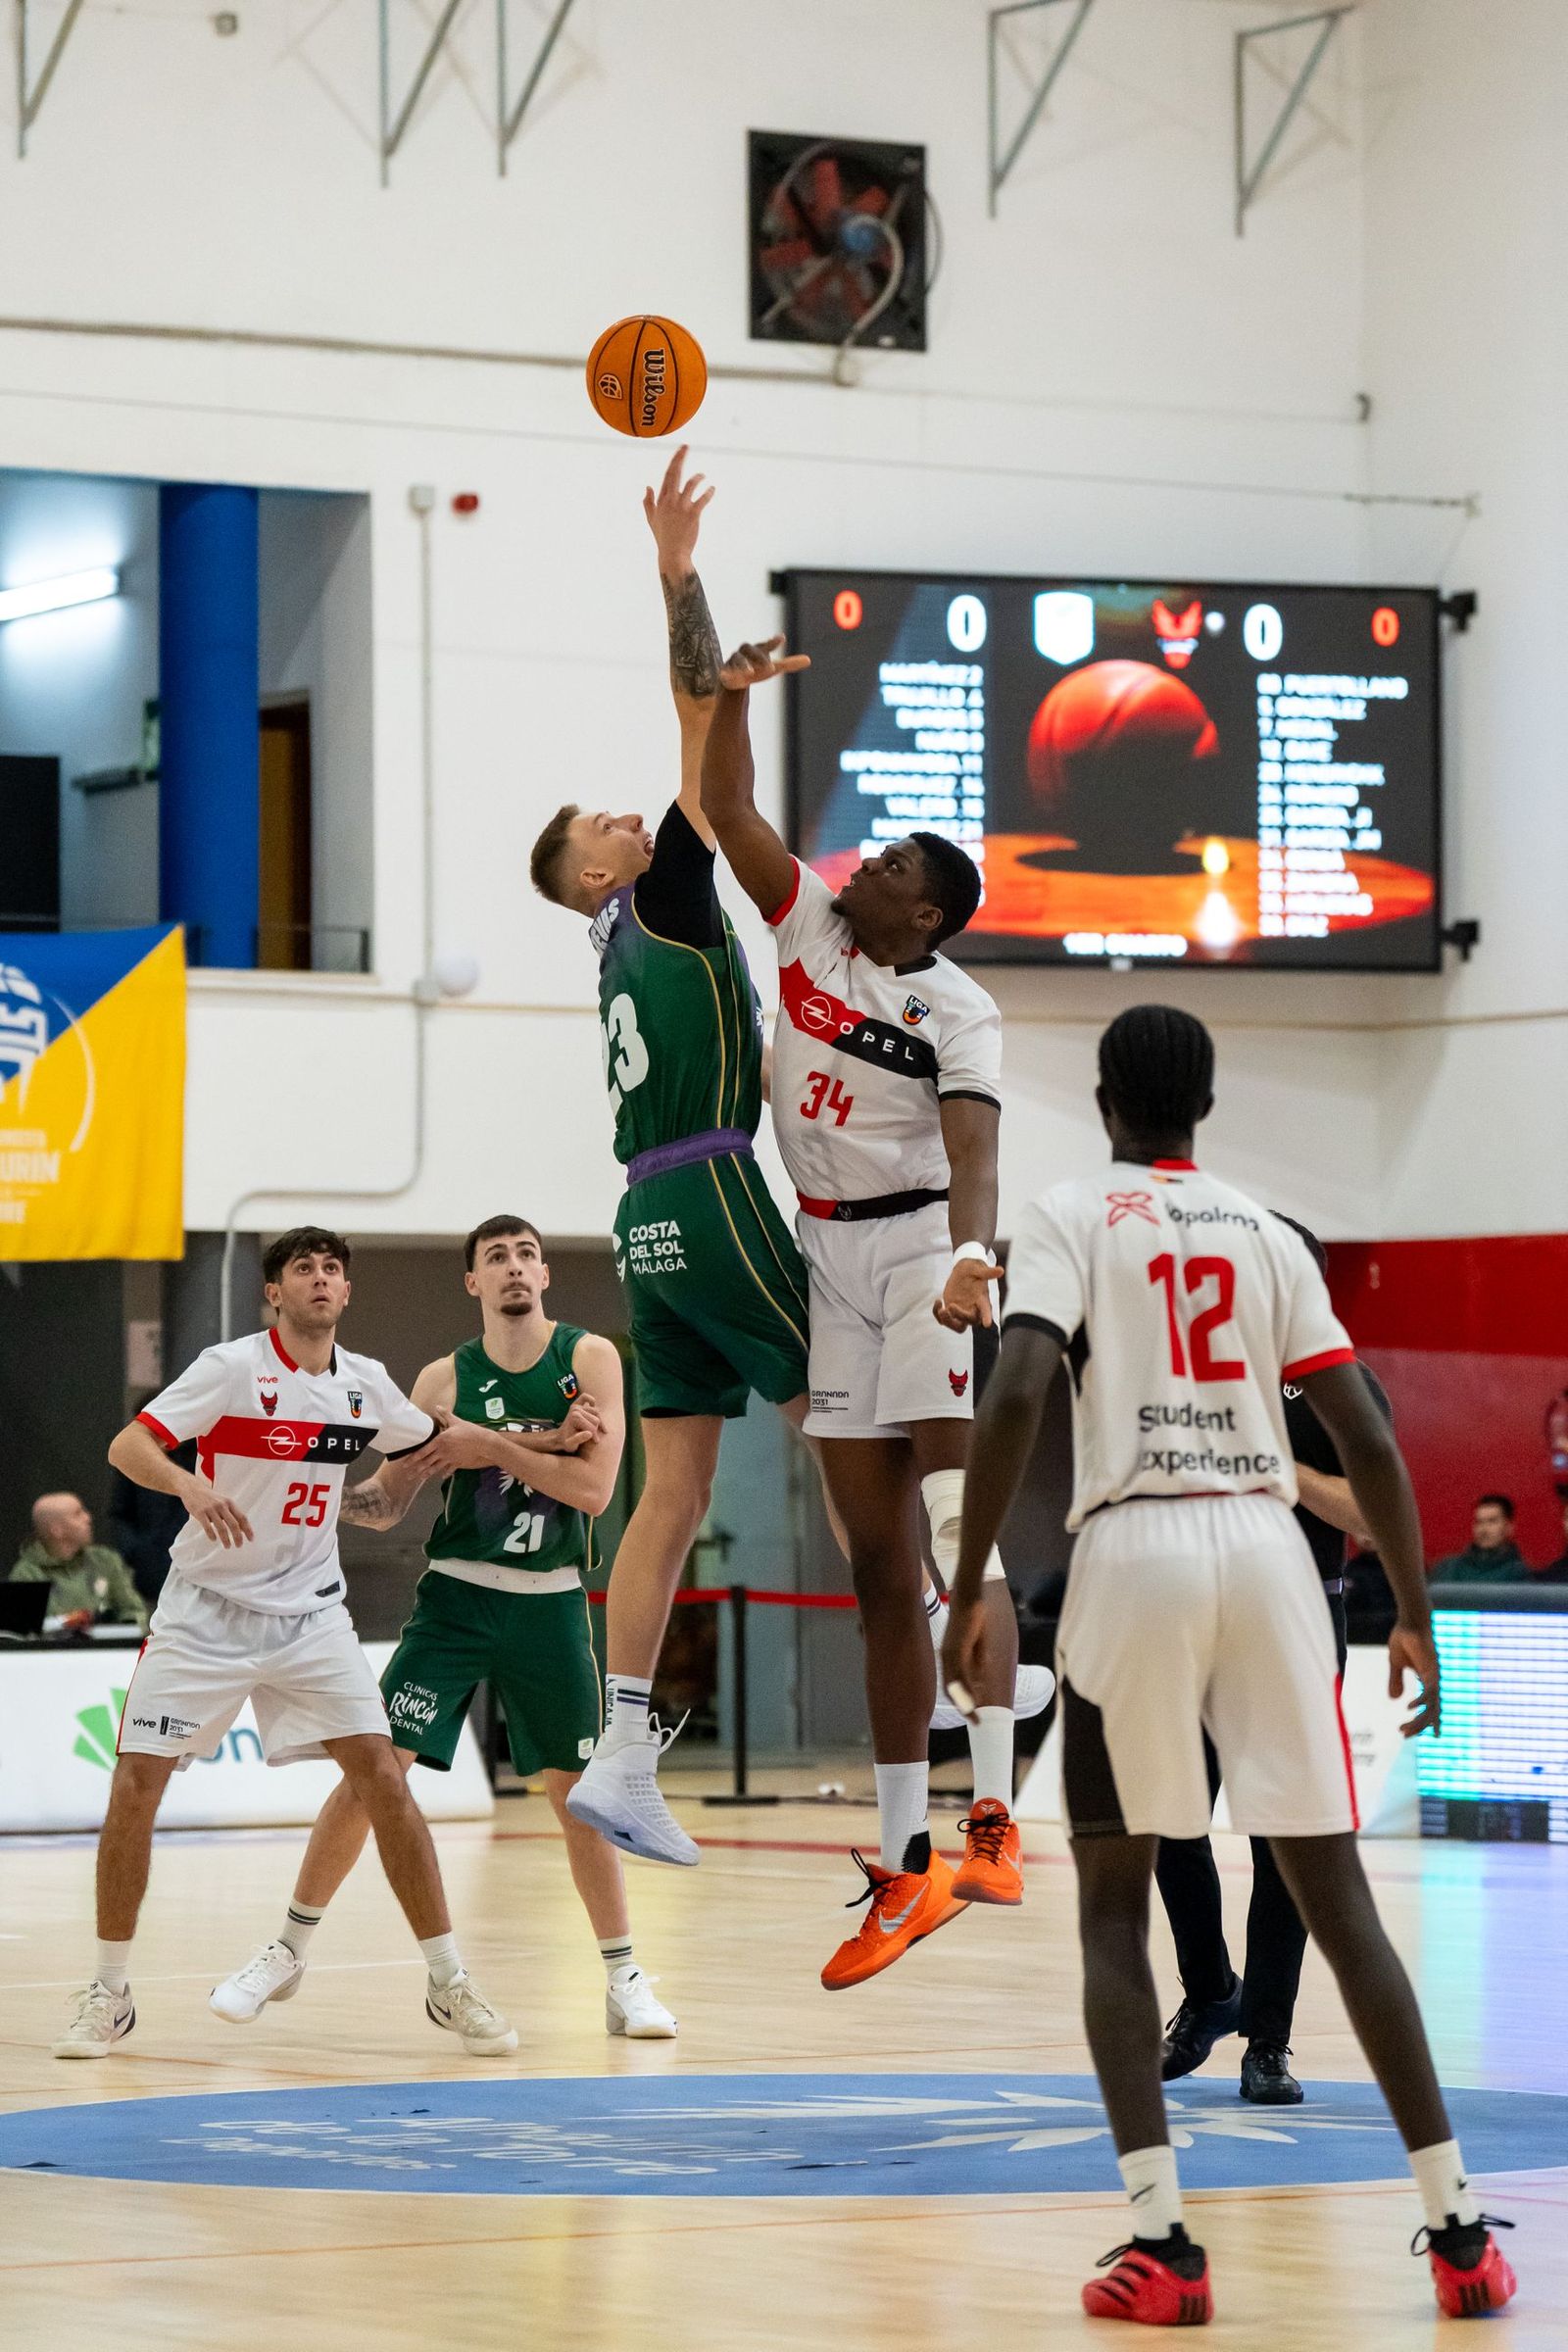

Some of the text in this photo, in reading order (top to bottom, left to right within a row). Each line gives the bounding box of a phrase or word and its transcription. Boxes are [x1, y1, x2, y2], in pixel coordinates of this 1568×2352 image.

[641, 348, 665, 426] Wilson
[833, 589, 863, 630] 0
[947, 594, 987, 653] 0
[1371, 607, 1400, 648] 0
[1244, 603, 1283, 662] 0
[908, 996, 928, 1013] LIGA
[839, 1020, 915, 1062] OPEL
[799, 1070, 855, 1127] 34
[628, 1219, 682, 1245] COSTA
[628, 1240, 685, 1260] DEL SOL
[631, 1256, 688, 1275] MÁLAGA
[1148, 1252, 1247, 1383] 12
[557, 1373, 575, 1387] LIGA
[811, 1390, 850, 1398] GRANADA
[811, 1397, 829, 1406] 2031
[307, 1436, 362, 1452] OPEL
[281, 1482, 331, 1528] 25
[503, 1511, 545, 1553] 21
[132, 1717, 157, 1729] vive
[389, 1716, 424, 1736] DENTAL
[199, 2120, 720, 2176] de la Torre
